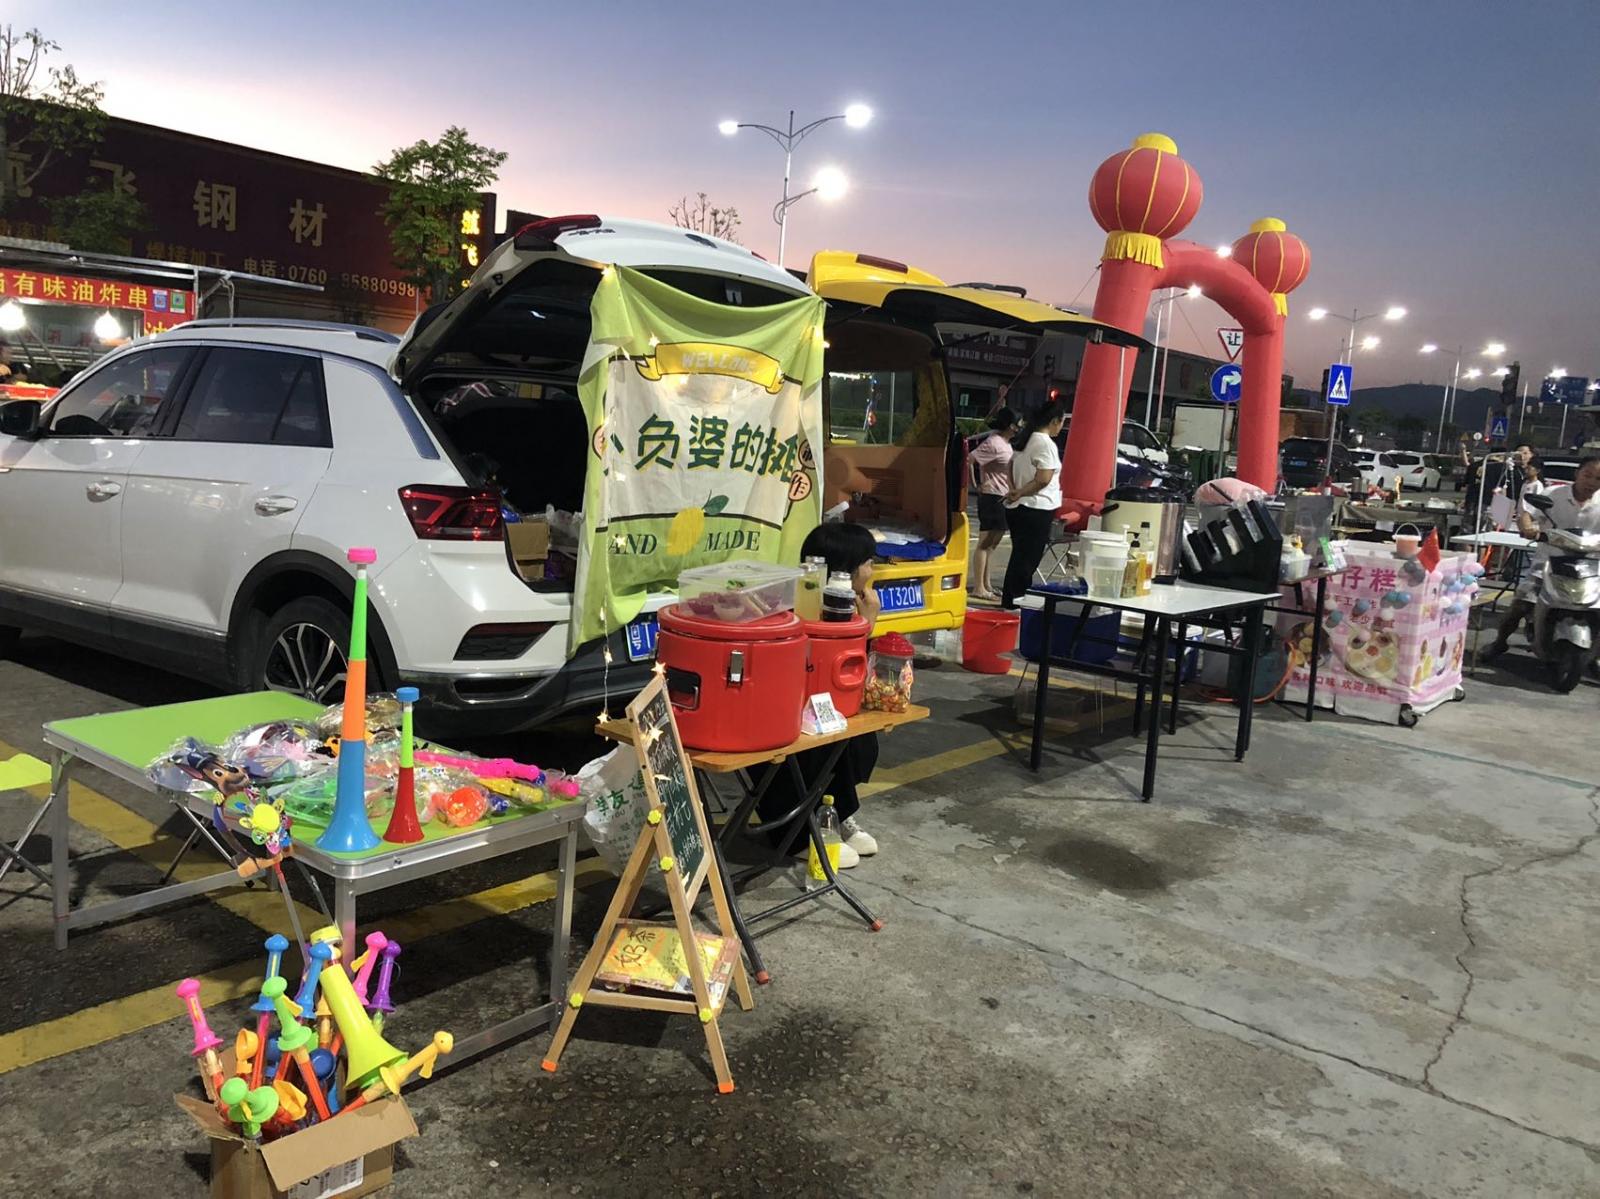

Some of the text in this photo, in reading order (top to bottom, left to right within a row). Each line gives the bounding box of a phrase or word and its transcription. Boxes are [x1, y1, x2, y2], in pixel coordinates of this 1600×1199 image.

[1226, 332, 1241, 346] 让
[604, 413, 798, 483] 负婆的摊
[703, 530, 761, 553] MADE
[1310, 565, 1398, 593] 仔糕
